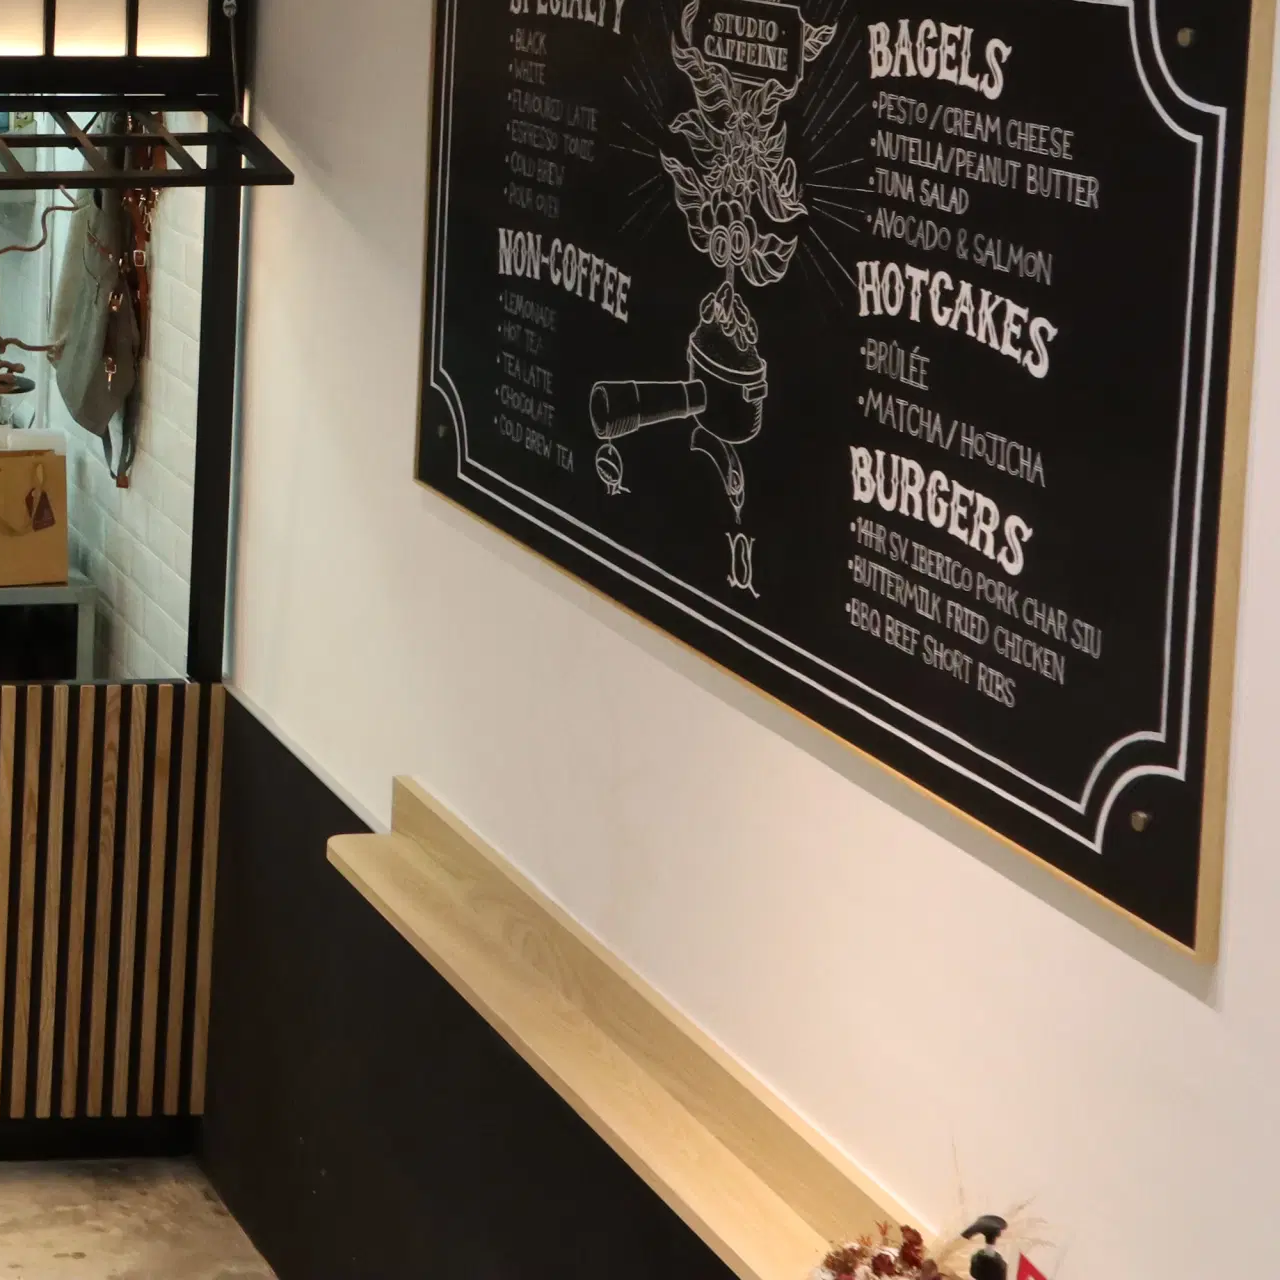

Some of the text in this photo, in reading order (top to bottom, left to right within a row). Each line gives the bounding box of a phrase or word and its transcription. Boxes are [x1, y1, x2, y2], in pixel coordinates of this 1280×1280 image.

[515, 28, 547, 55] BLACK
[713, 12, 779, 42] STUDIO
[514, 58, 546, 86] WHITE
[704, 34, 788, 72] CAFFEINE
[868, 18, 1012, 100] BAGELS
[511, 120, 596, 162] ESPRESSO TONIC
[567, 105, 599, 132] LATTE
[1006, 119, 1075, 160] CHEESE
[510, 151, 566, 188] COLD BREW
[875, 167, 970, 215] TUNA SALAD
[1026, 163, 1100, 210] BUTTER
[873, 207, 1053, 286] AVOCADO & SALMON
[498, 227, 632, 323] NON-COFFEE
[504, 290, 557, 331] LEMONADE
[856, 260, 1058, 379] HOTCAKES
[503, 320, 544, 354] HOT TEA
[502, 351, 553, 395] TEA LATTE
[865, 337, 930, 390] BRÛLÉE
[500, 384, 556, 427] CHOCOLATE
[499, 414, 575, 472] COLD BREW TEA
[850, 446, 1033, 576] BURGERS
[853, 554, 1066, 685] BUTTERMILK FRIED CHICKEN
[911, 542, 973, 592] IBERICO
[976, 572, 1019, 619] PORK
[1022, 597, 1068, 643] CHAR
[1070, 618, 1102, 659] SIU
[850, 597, 1017, 708] BBQ BEEF SHORT RIBS
